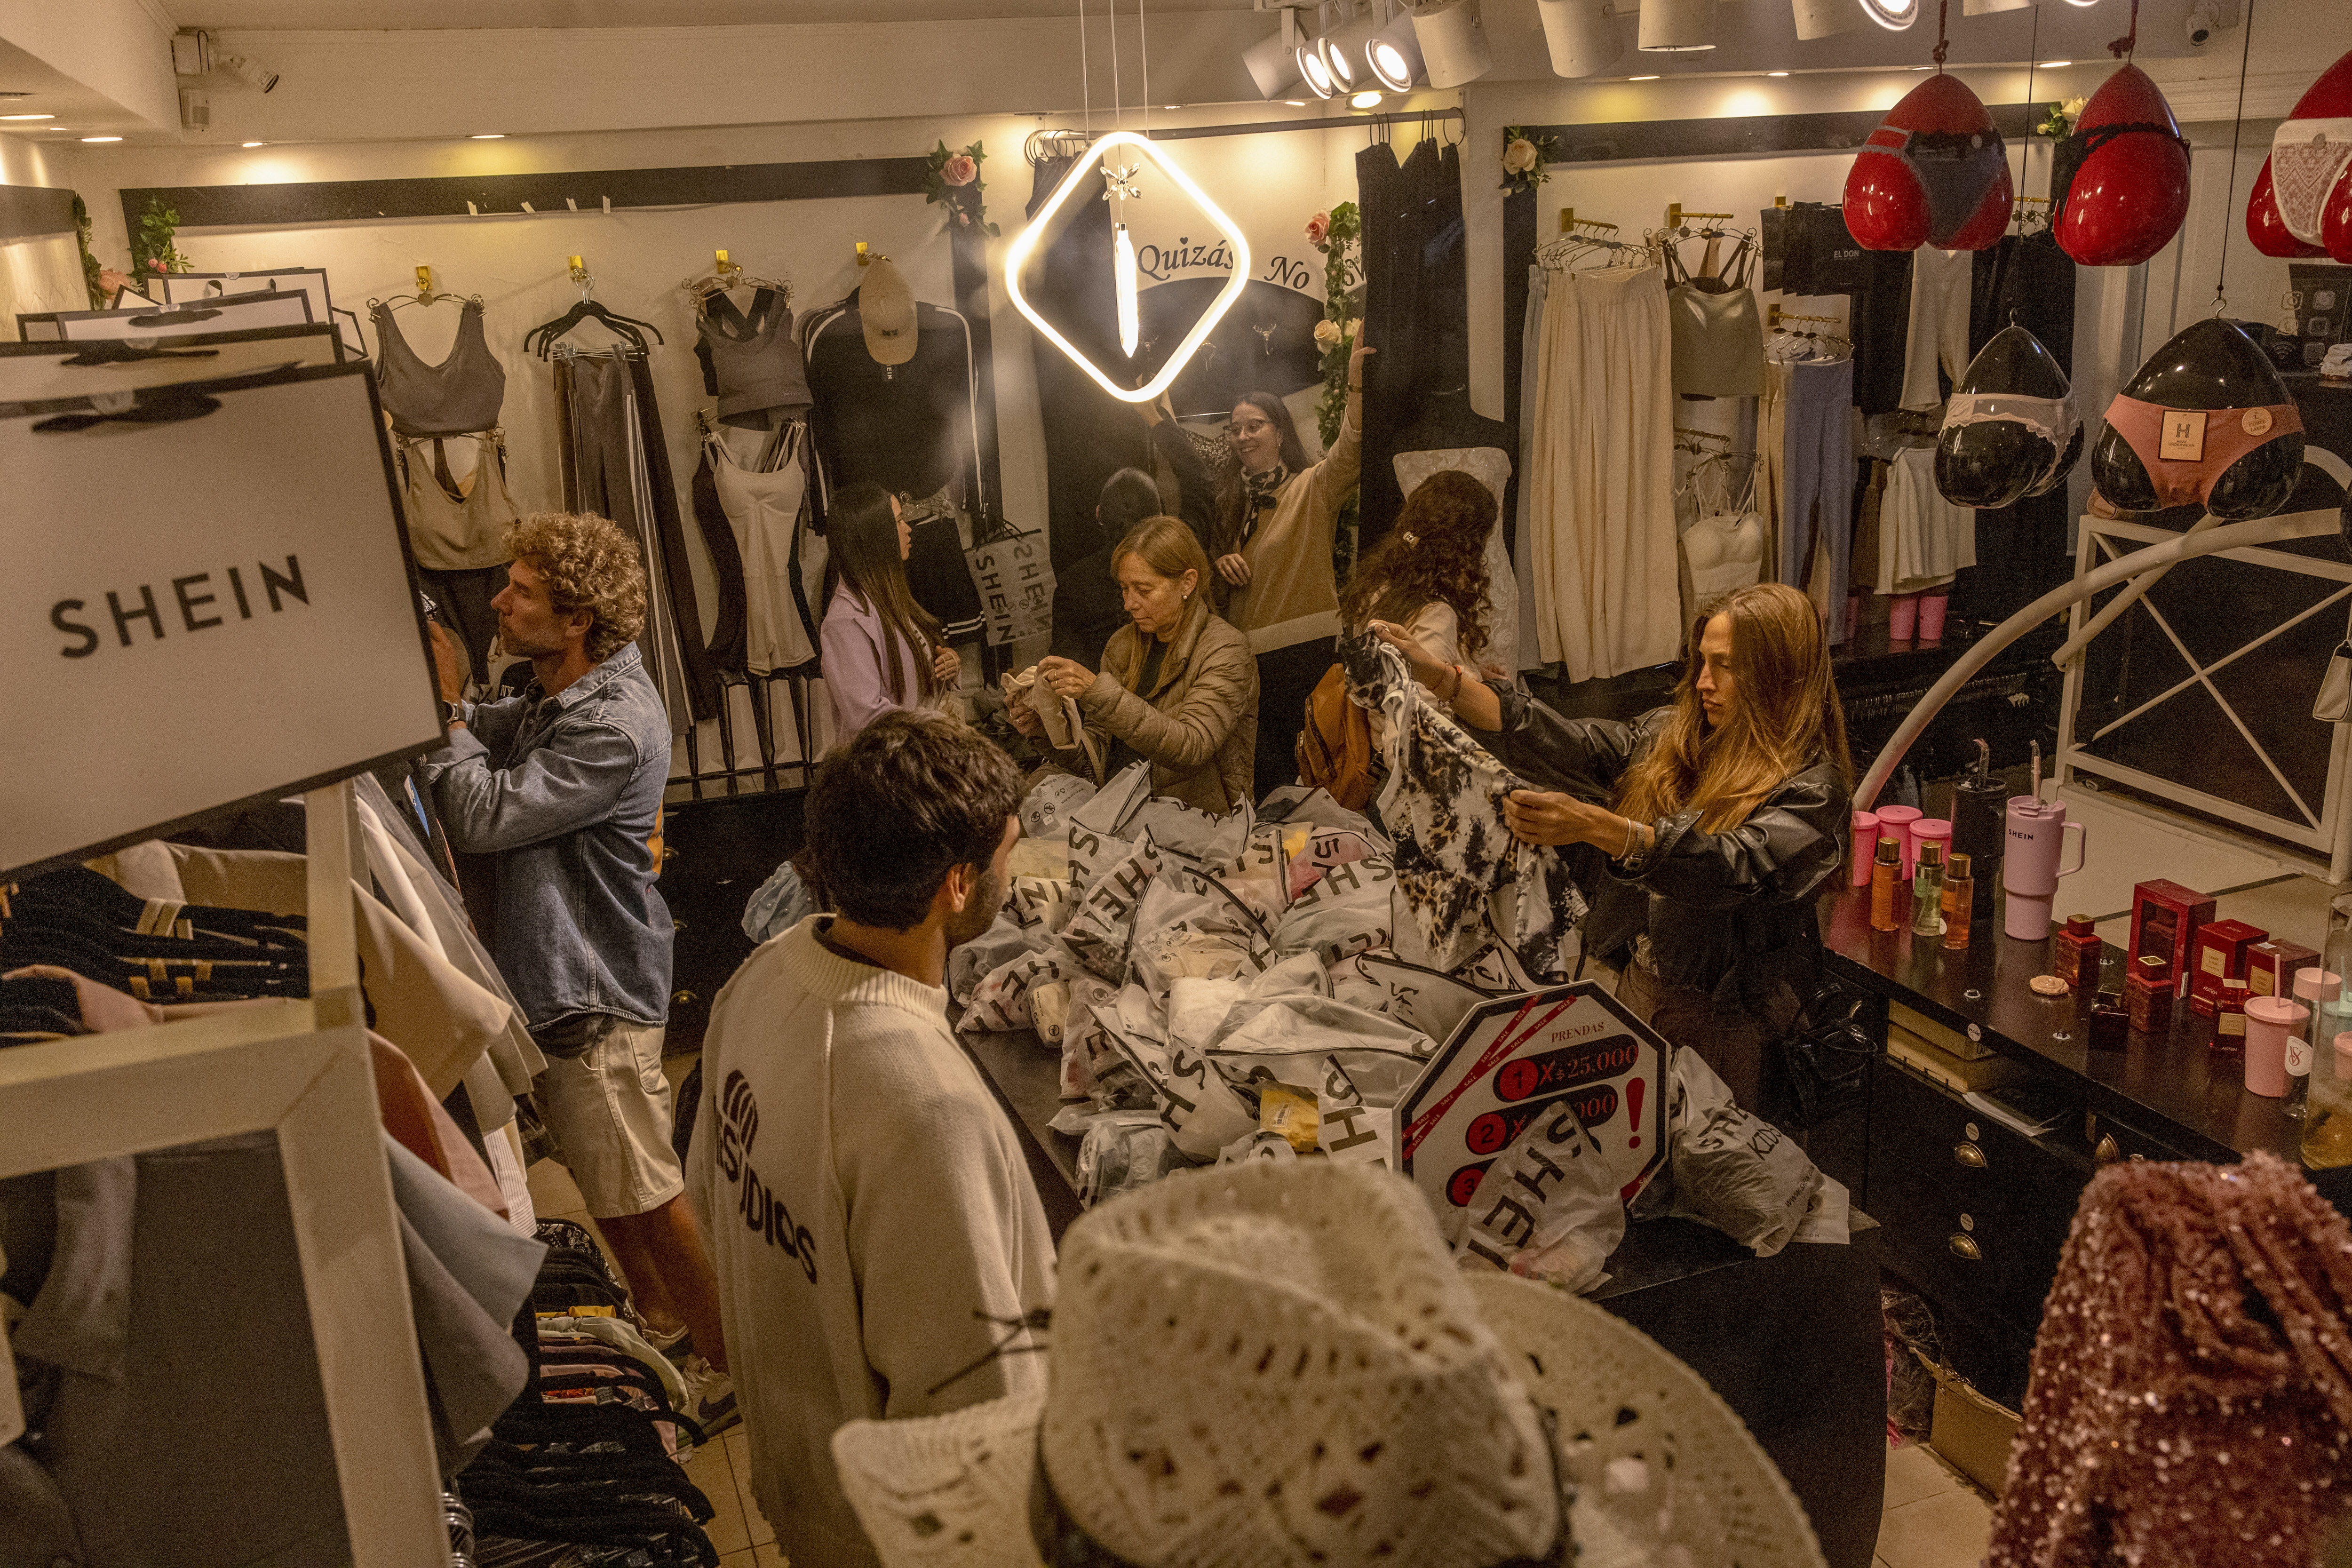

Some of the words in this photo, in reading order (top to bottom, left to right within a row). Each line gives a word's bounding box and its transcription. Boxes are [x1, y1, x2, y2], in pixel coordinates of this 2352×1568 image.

[1264, 256, 1310, 289] No
[50, 554, 310, 659] SHEIN
[976, 555, 1017, 642] SHEIN
[2008, 828, 2034, 841] SHEIN
[2202, 986, 2218, 995] ASTEN
[1552, 1022, 1604, 1043] PRENDAS
[1417, 1114, 1430, 1126] SALE
[1440, 1094, 1454, 1106] SALE
[1464, 1075, 1477, 1087] SALE
[1487, 1056, 1501, 1068] SALE
[1510, 1037, 1524, 1050] SALE
[1534, 1018, 1547, 1030] SALE
[1557, 999, 1572, 1011] SALE
[1481, 1051, 1492, 1063] SALE
[1513, 1070, 1522, 1089] 1
[1480, 1123, 1494, 1145] 2
[1463, 1178, 1475, 1196] 3
